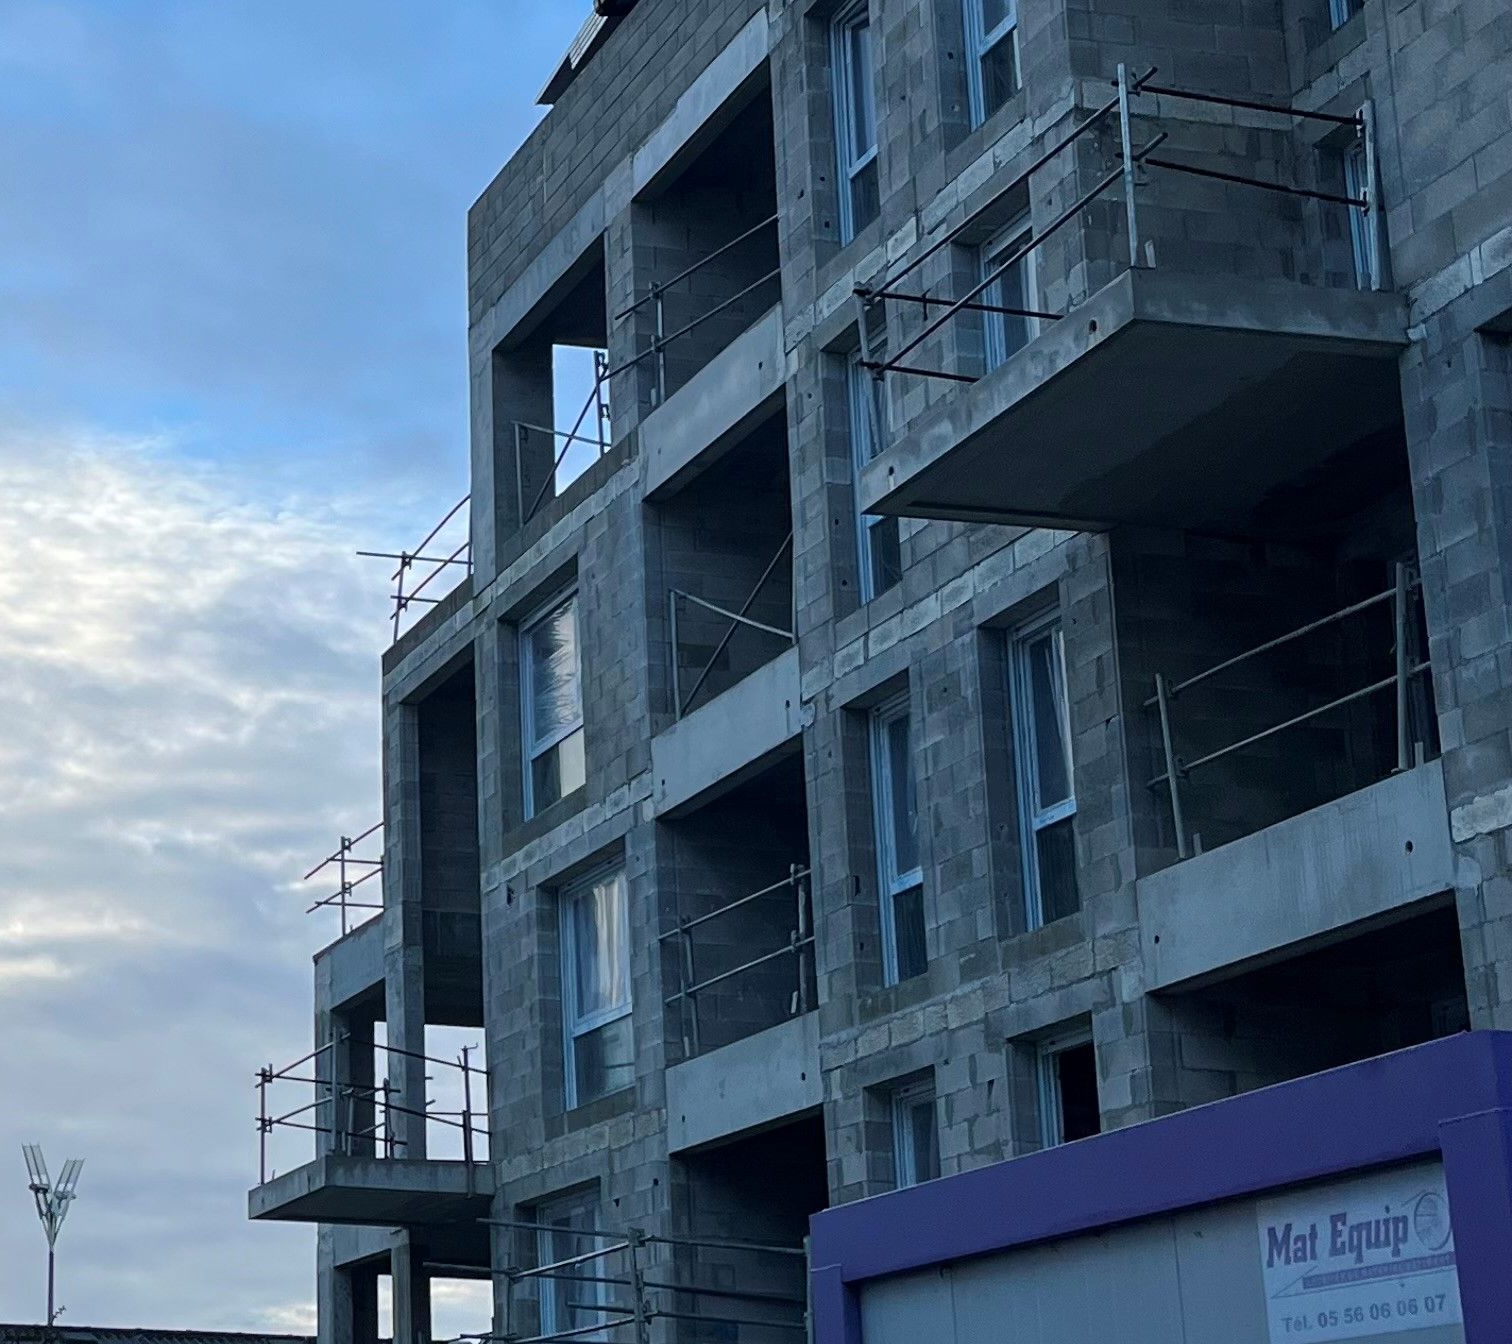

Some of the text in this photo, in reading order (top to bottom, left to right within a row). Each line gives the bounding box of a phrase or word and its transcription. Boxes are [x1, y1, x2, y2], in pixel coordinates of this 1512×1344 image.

[1267, 1205, 1409, 1268] Mat Equip
[1317, 1311, 1338, 1329] 05
[1369, 1302, 1391, 1321] 06
[1397, 1298, 1419, 1317] 06
[1424, 1294, 1447, 1314] 07
